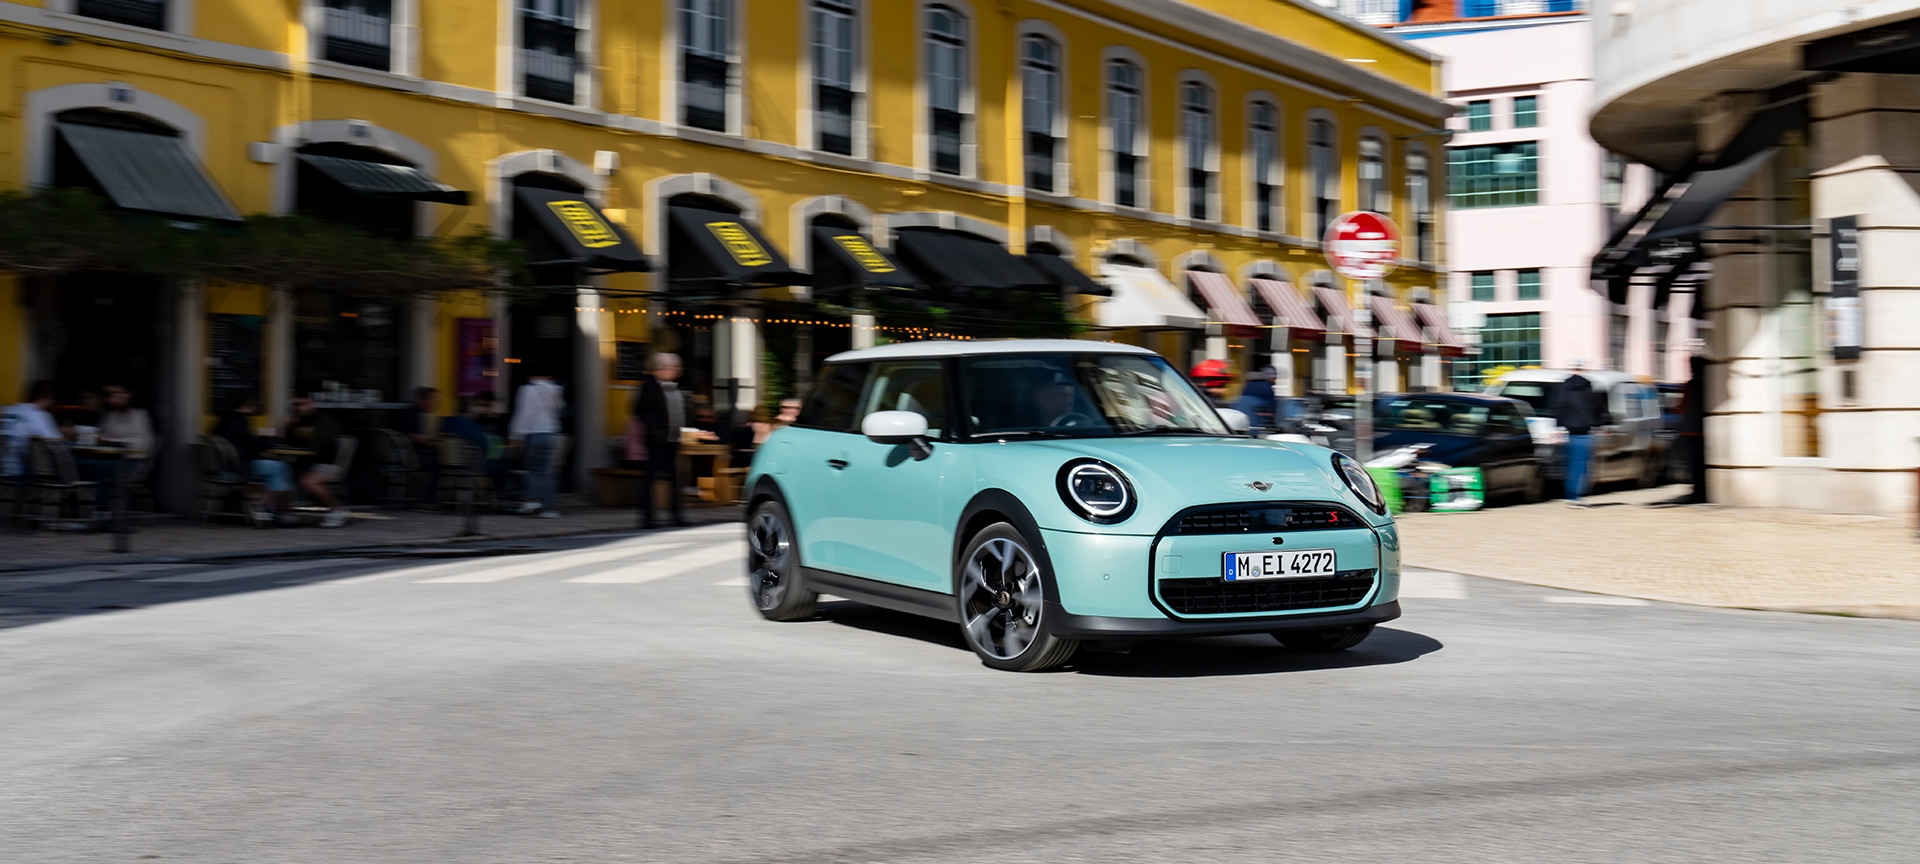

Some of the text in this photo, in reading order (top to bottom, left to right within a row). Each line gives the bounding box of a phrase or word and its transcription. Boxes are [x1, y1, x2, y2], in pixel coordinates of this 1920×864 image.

[1328, 511, 1338, 523] S
[1238, 552, 1333, 577] M EI 4272
